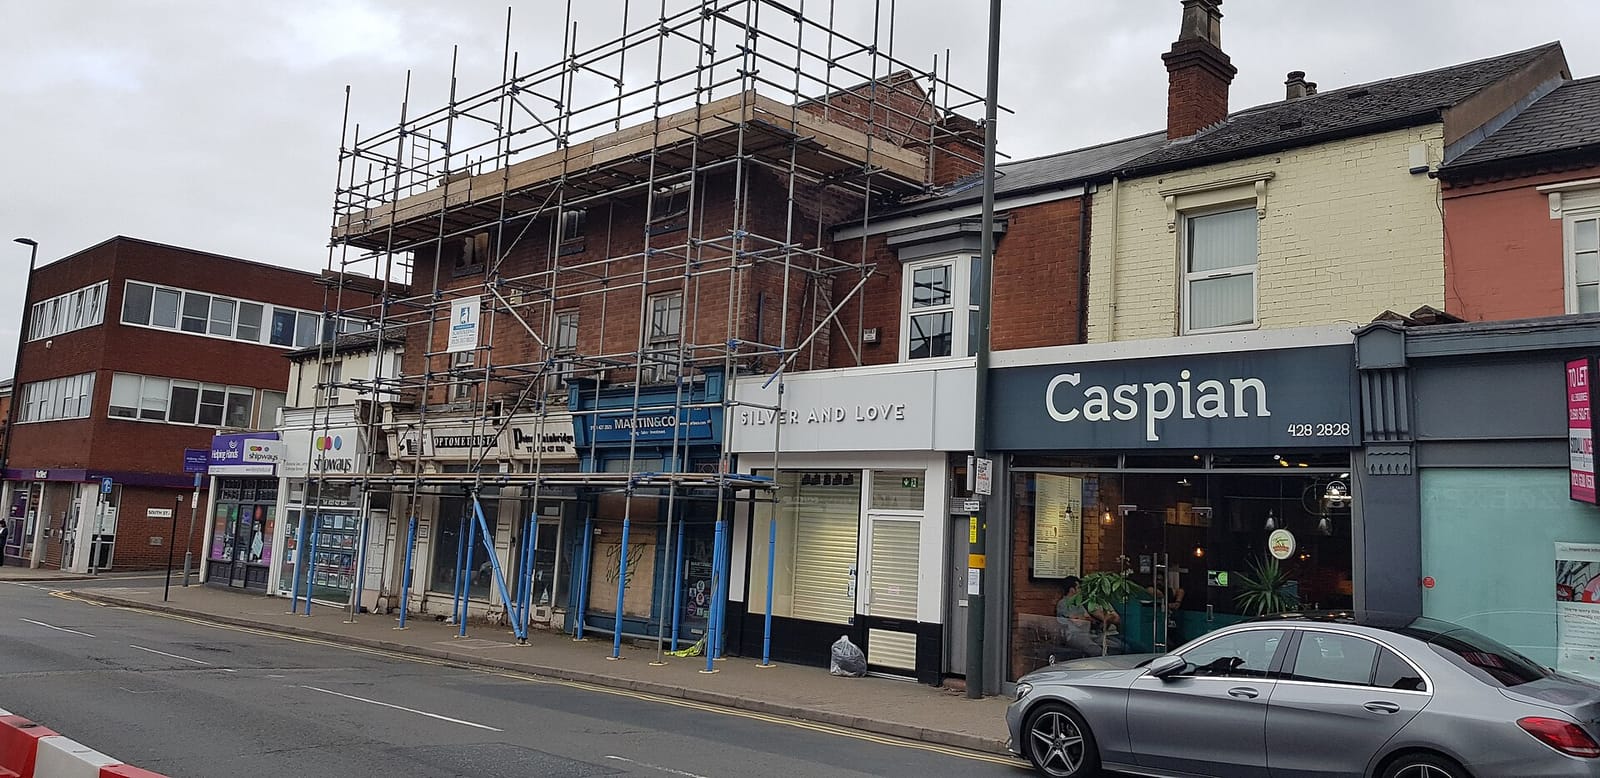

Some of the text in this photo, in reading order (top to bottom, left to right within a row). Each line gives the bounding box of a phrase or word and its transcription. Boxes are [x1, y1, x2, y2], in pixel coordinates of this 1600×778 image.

[1568, 366, 1588, 387] TO LET
[741, 404, 905, 426] SILVER AND LOVE
[1045, 370, 1271, 441] Caspian
[1287, 423, 1350, 437] 428 2828
[249, 452, 278, 462] shipways
